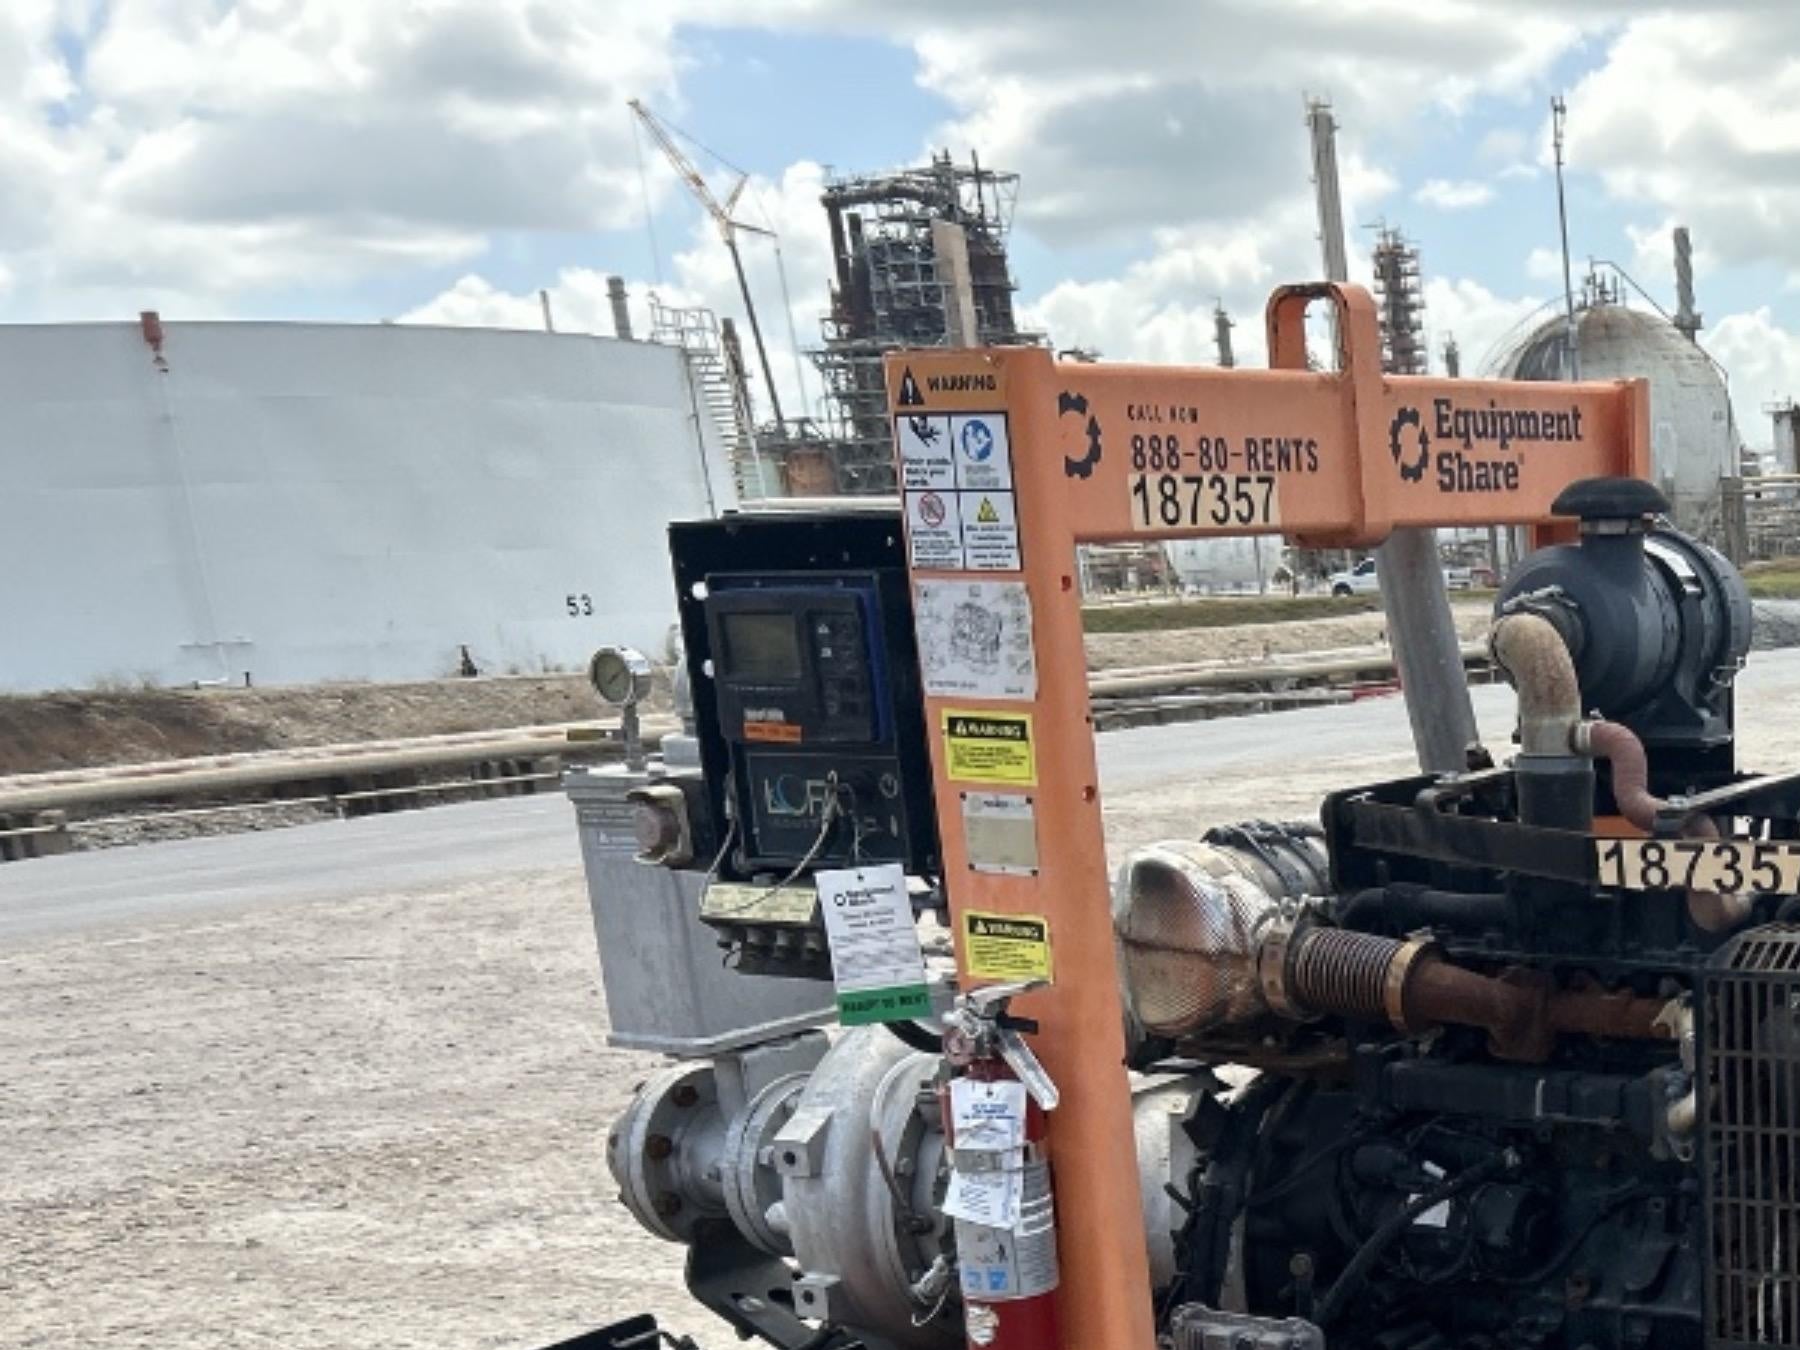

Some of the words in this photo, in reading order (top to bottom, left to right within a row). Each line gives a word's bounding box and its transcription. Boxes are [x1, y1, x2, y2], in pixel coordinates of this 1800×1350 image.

[1127, 404, 1162, 423] CALL
[1433, 398, 1584, 449] Equipment
[1131, 433, 1319, 473] 888-80-RENTS
[1132, 473, 1276, 526] 187357
[566, 593, 594, 618] 53
